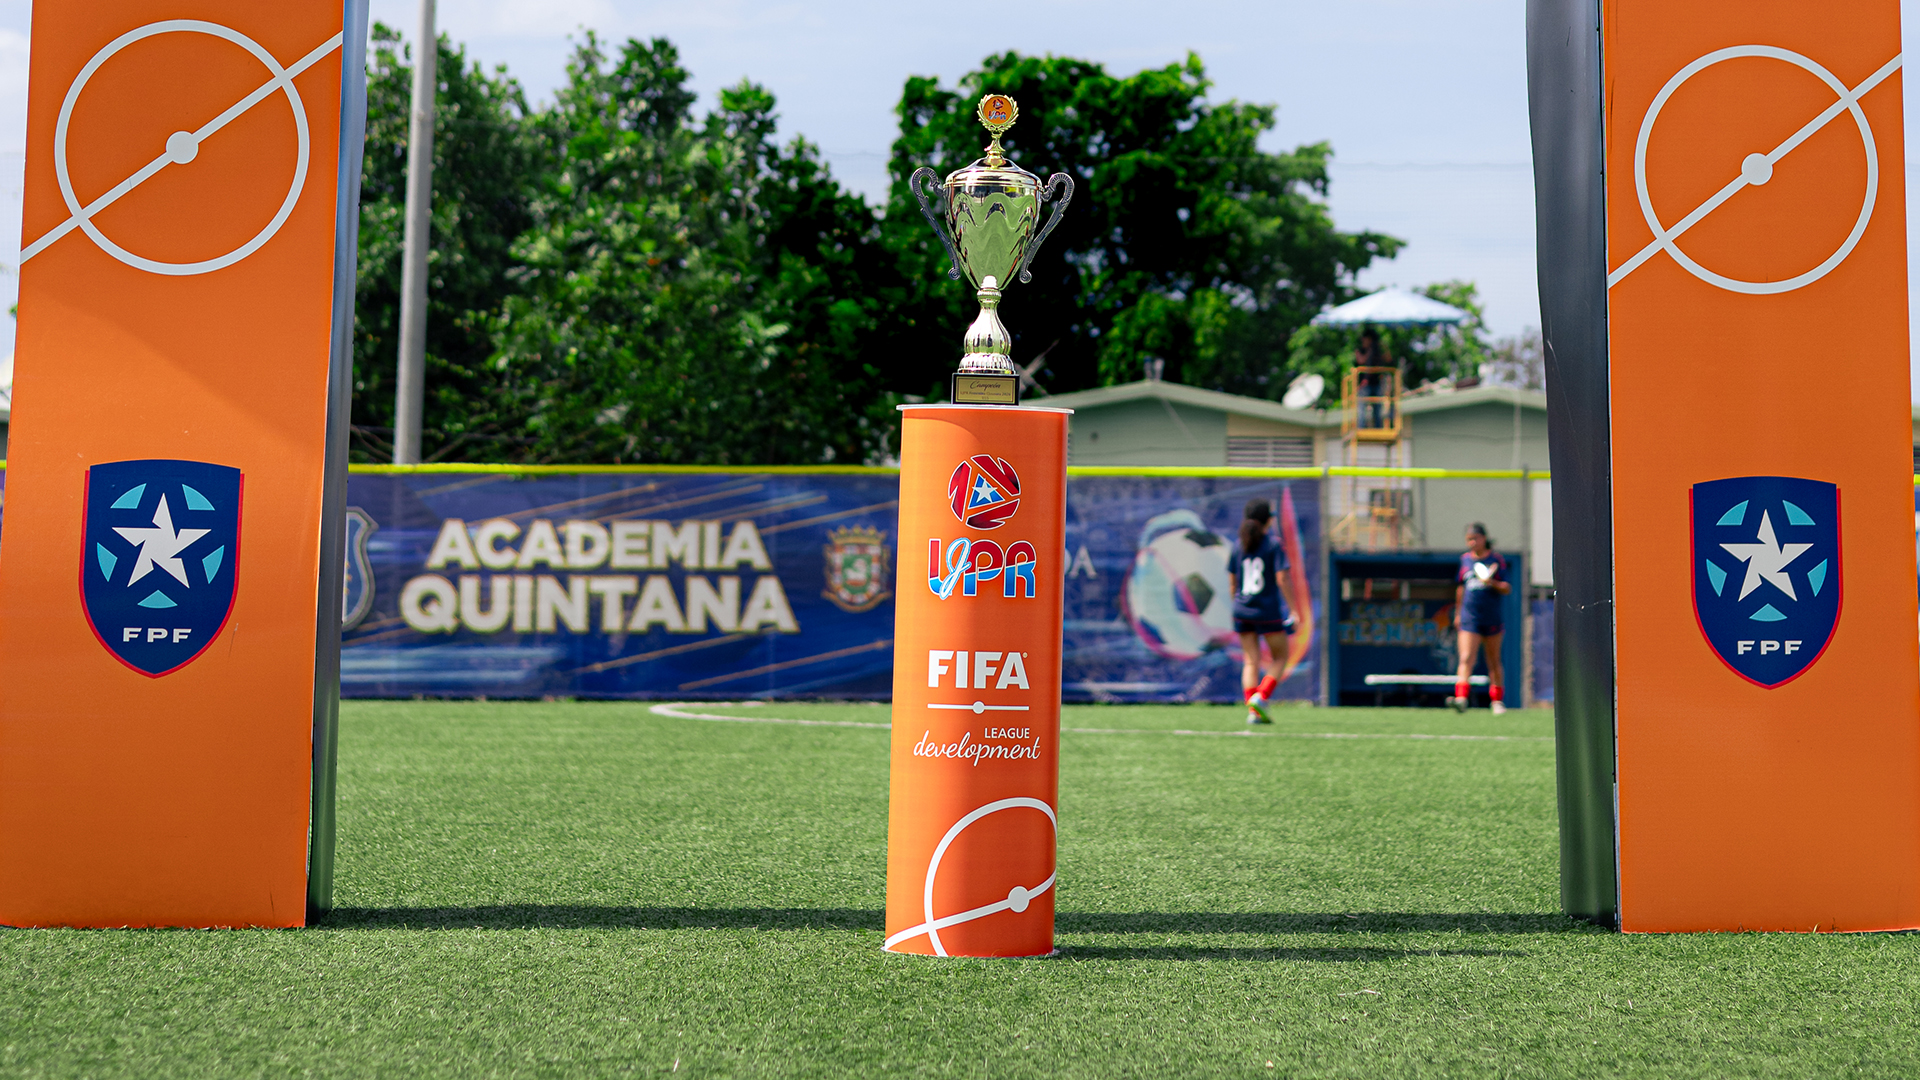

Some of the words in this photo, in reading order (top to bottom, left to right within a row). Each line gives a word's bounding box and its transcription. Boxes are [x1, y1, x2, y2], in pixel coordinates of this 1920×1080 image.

[427, 518, 771, 570] ACADEMIA
[1242, 556, 1265, 595] 18
[401, 575, 799, 633] QUINTANA
[123, 627, 192, 643] FPF
[1737, 640, 1803, 655] FPF
[928, 649, 1030, 690] FIFA
[913, 729, 1041, 767] development
[984, 727, 1030, 739] LEAGUE
